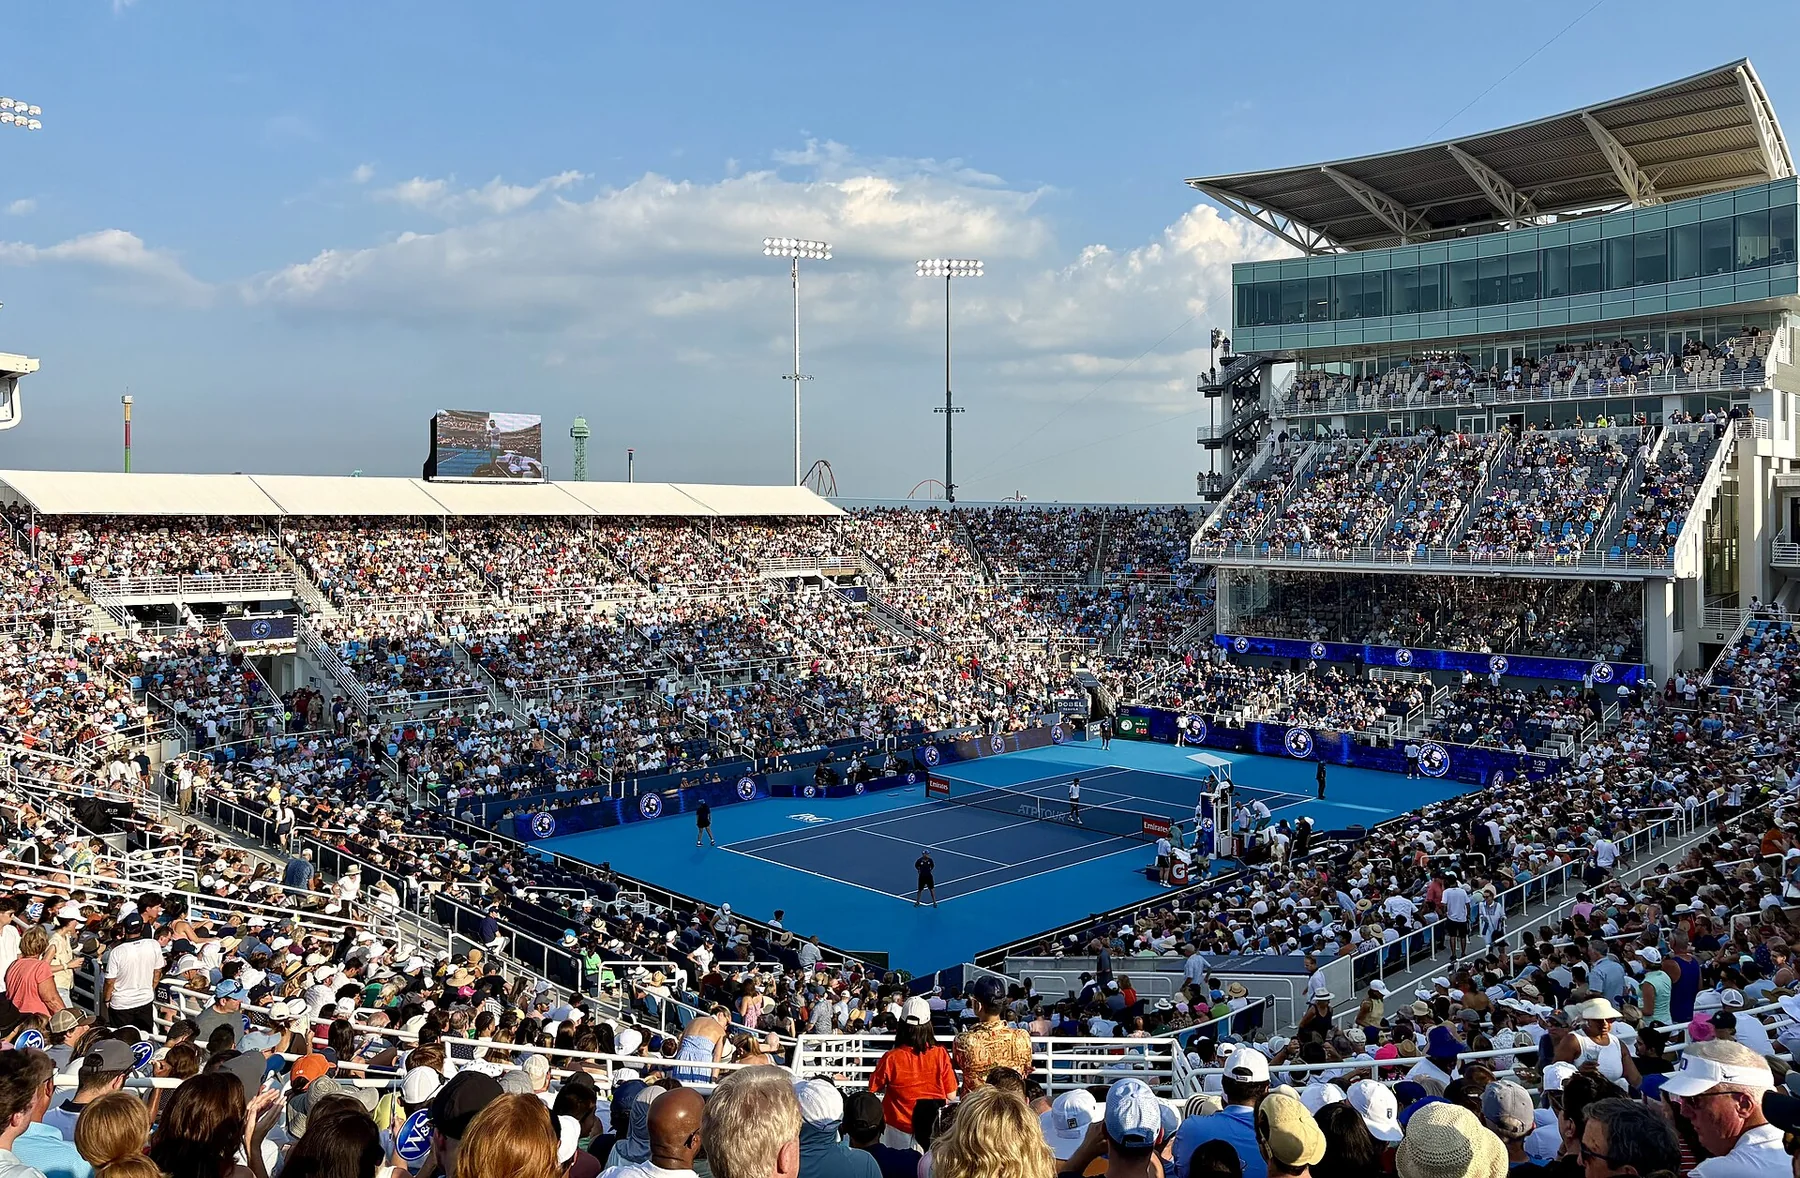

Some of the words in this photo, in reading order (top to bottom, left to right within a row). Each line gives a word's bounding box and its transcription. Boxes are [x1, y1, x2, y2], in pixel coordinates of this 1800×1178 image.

[930, 780, 948, 790] Emirates
[1018, 804, 1038, 816] ATP
[1040, 808, 1066, 822] TOUR
[1144, 822, 1168, 832] Emirates
[1172, 864, 1186, 879] G
[158, 990, 168, 1000] 203
